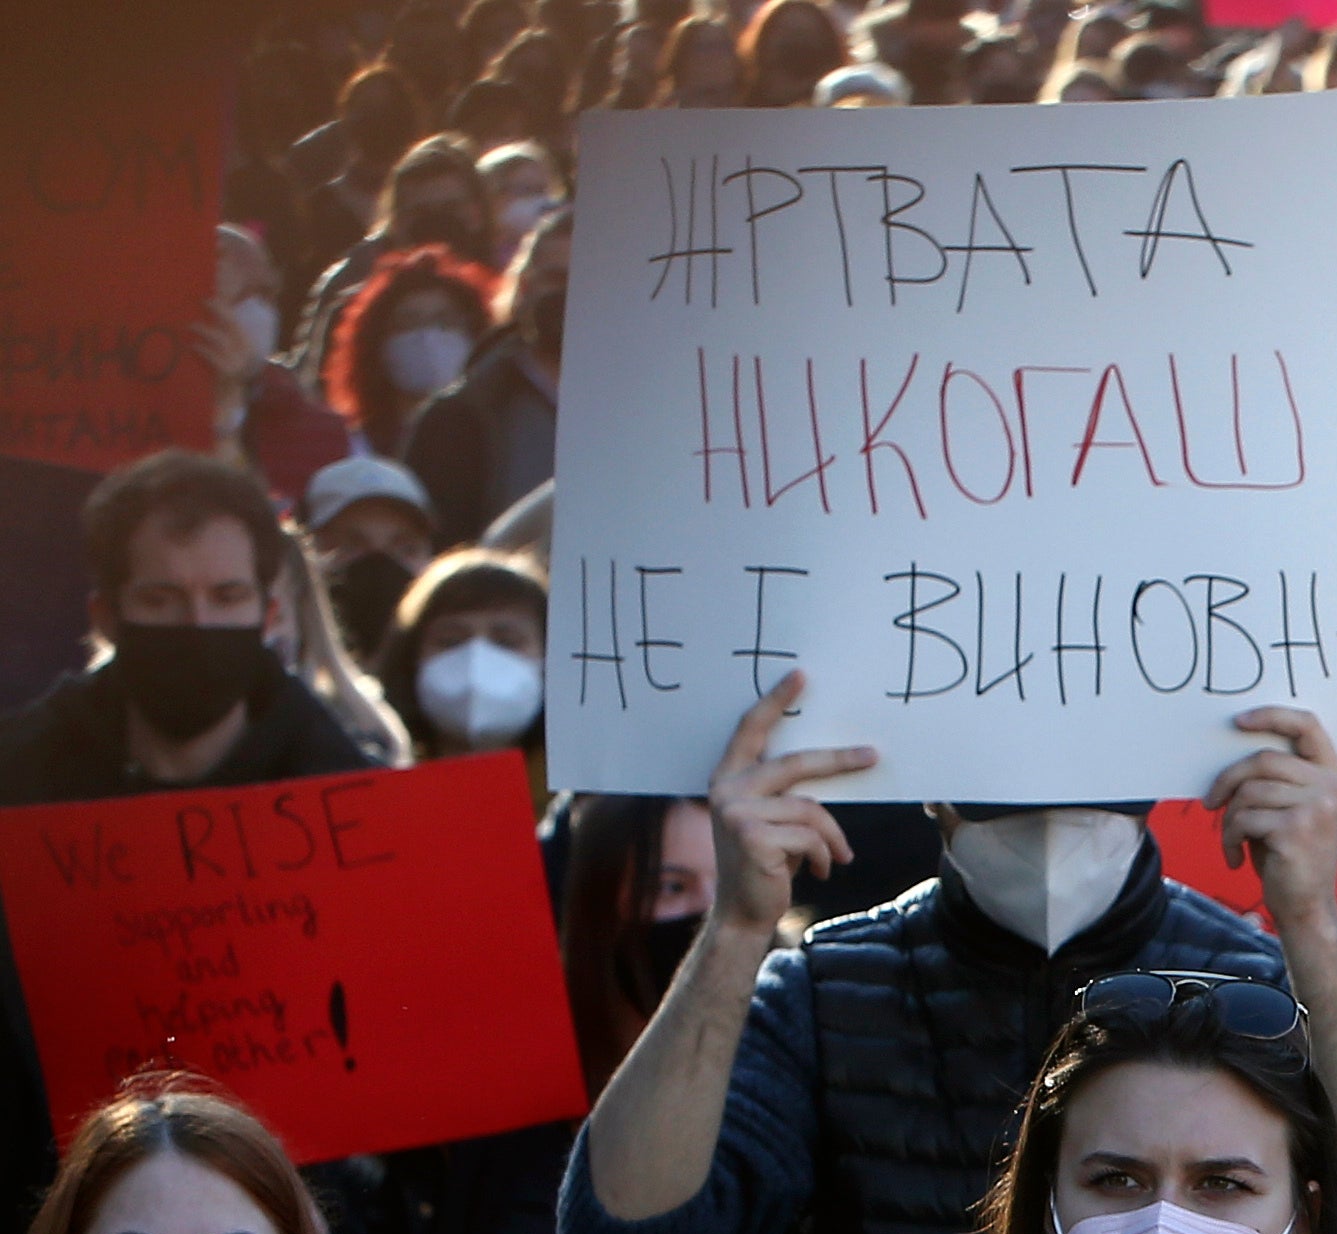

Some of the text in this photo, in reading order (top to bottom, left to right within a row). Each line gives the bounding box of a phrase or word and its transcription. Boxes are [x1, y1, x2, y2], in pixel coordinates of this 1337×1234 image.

[648, 154, 1254, 312] ЖРТВАТА
[693, 347, 1305, 519] НИКОГАШ
[572, 558, 684, 710] НЕ
[732, 566, 809, 716] Е
[41, 778, 396, 890] We RISE
[112, 893, 318, 949] supporting
[177, 943, 241, 984] and
[136, 988, 285, 1034] helping
